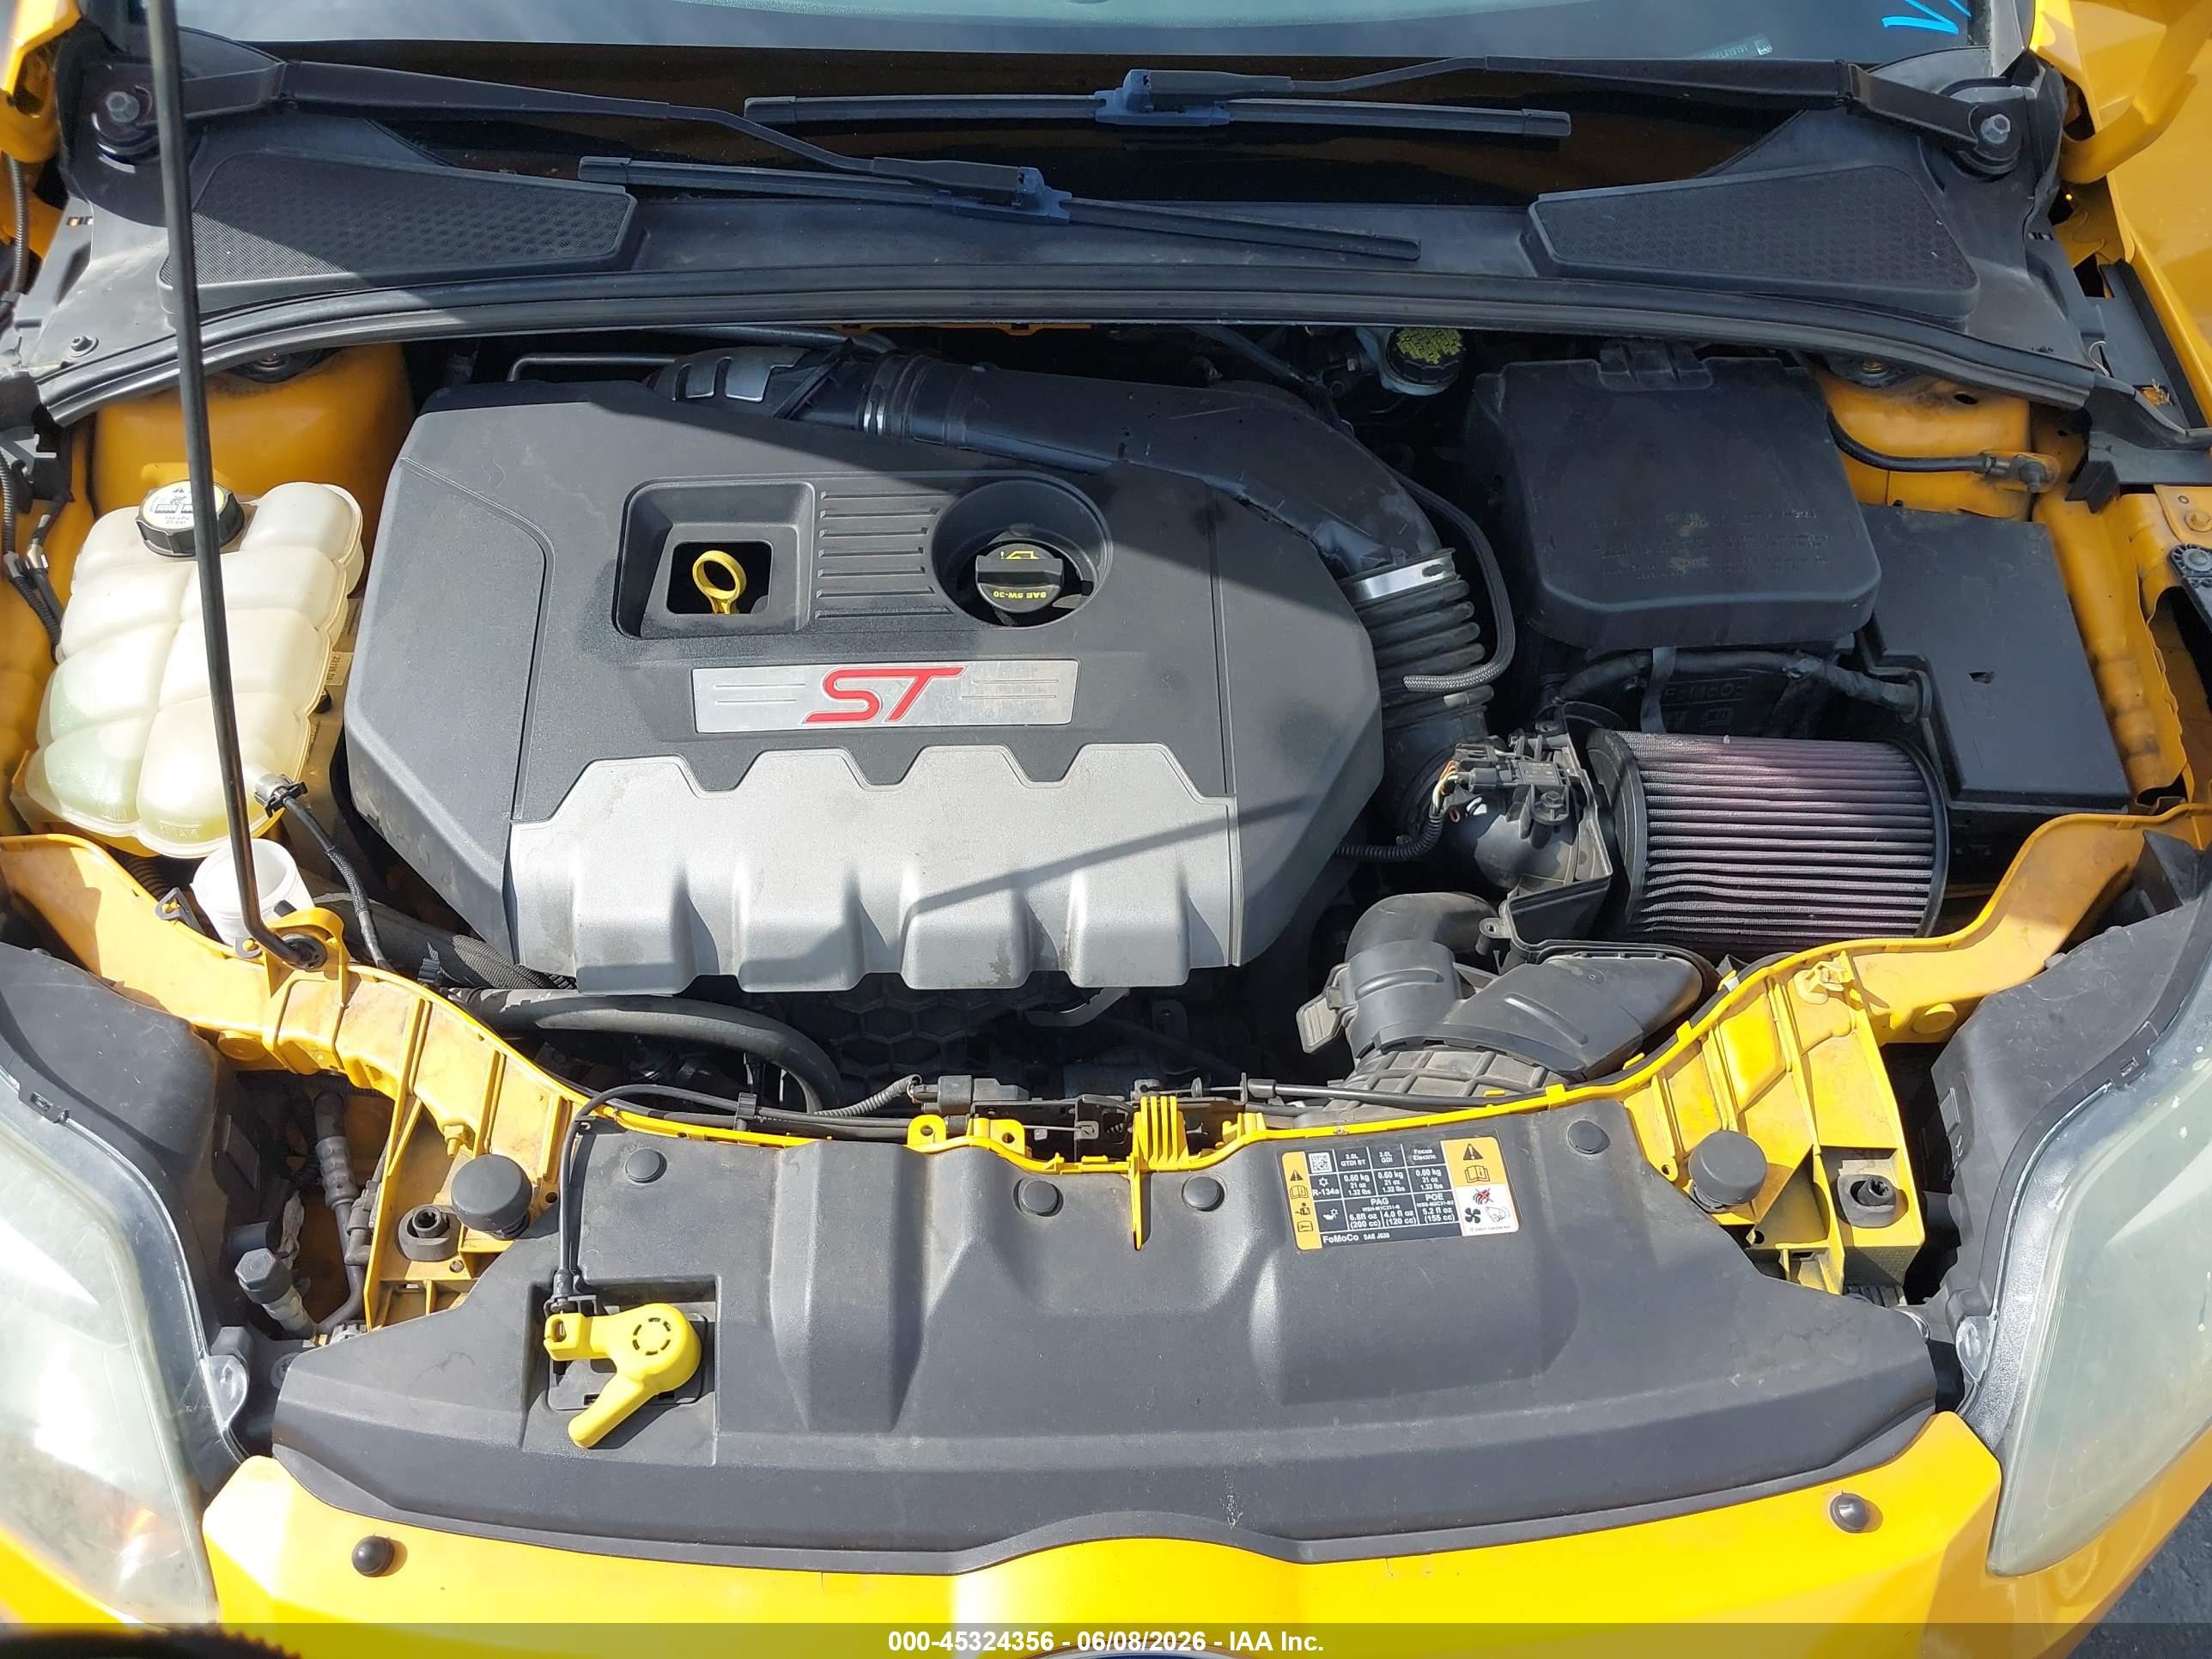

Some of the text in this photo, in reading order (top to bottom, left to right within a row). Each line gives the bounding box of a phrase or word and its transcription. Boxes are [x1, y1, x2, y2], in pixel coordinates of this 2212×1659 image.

[993, 590, 1047, 599] SAE 5W-30
[799, 665, 969, 725] ST
[1394, 1170, 1404, 1179] kg
[1415, 1168, 1442, 1177] 0.60 kg
[1343, 1173, 1370, 1182] 0.60 kg
[1312, 1188, 1340, 1196] R-134a
[1370, 1197, 1389, 1206] PAG
[1425, 1193, 1444, 1201] POE
[1385, 1216, 1417, 1227] (120 cc)
[1424, 1213, 1455, 1224] (155 cc)
[1350, 1219, 1382, 1230] (200 cc)
[1322, 1234, 1359, 1244] FoMoCo
